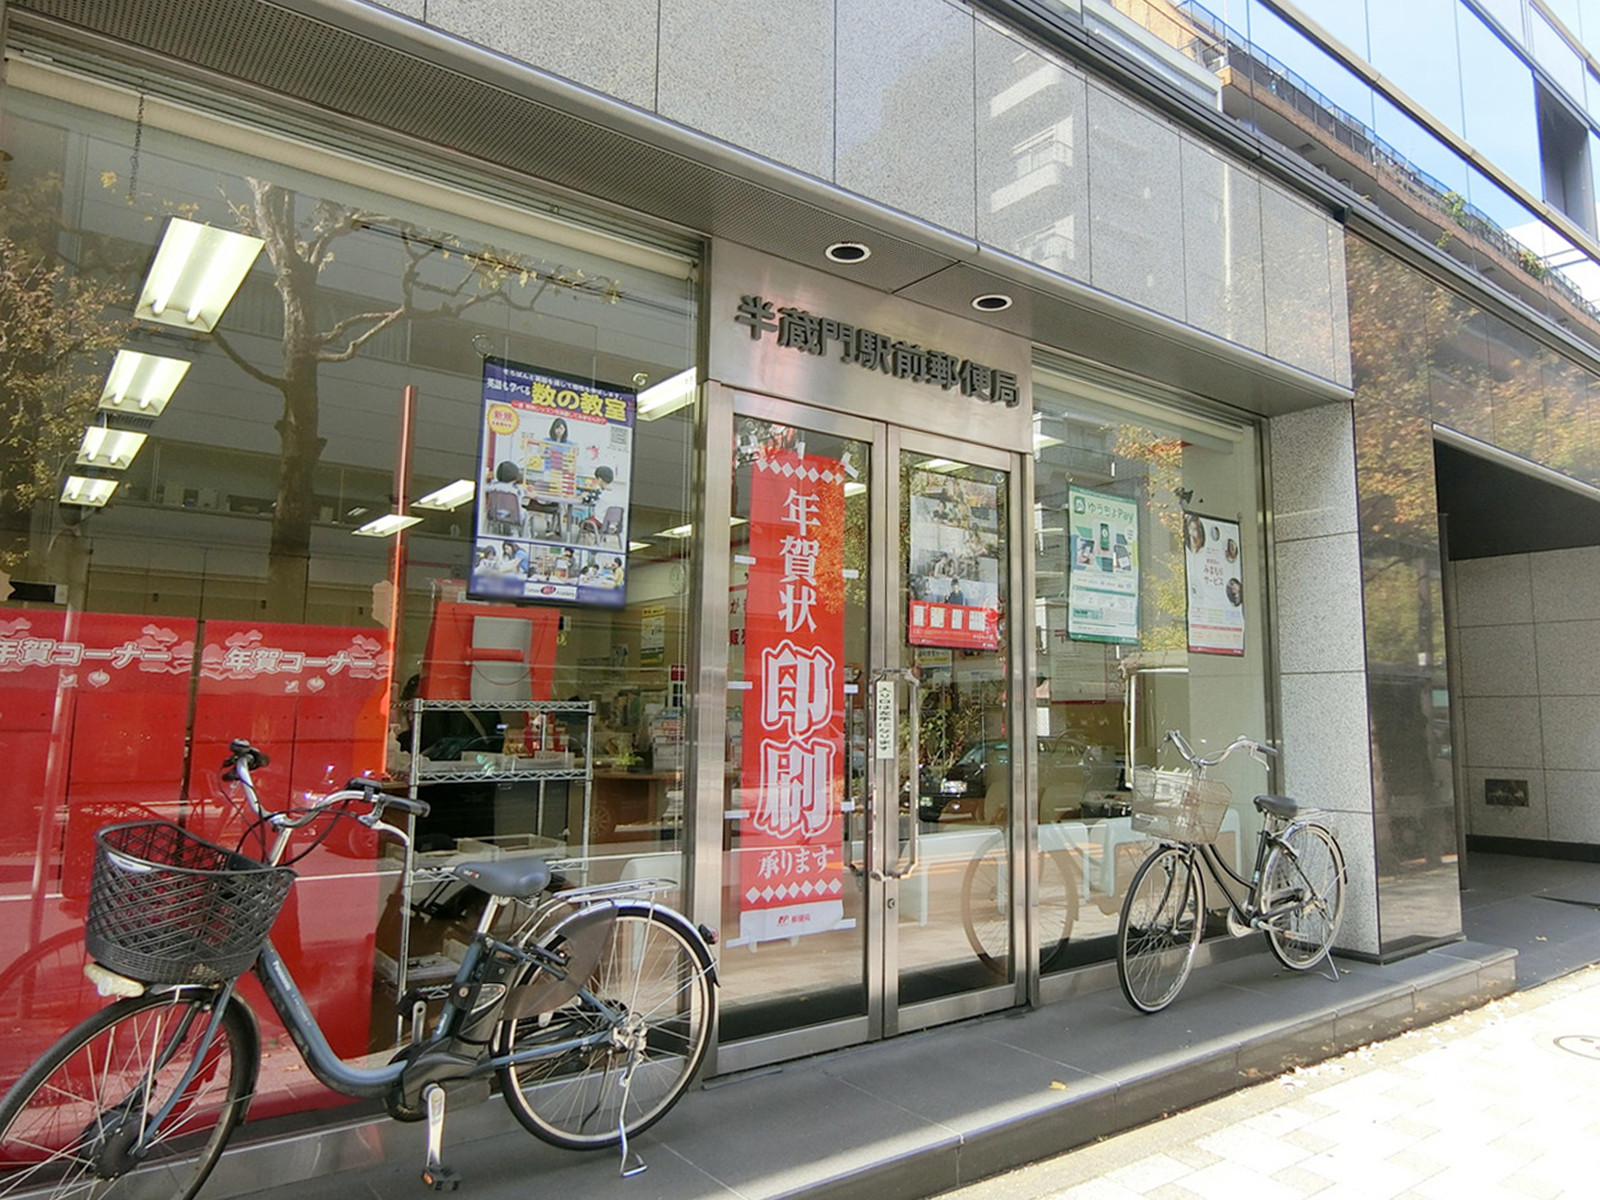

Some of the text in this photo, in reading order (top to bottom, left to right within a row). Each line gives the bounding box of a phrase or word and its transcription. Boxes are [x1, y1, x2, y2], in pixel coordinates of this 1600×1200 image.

[735, 295, 1020, 407] 半蔵門駅前郵便局
[531, 381, 627, 422] 数の教室
[778, 487, 821, 634] 年賀状
[224, 647, 376, 676] 年賀コーナー
[753, 639, 836, 840] 印刷
[757, 844, 834, 880] 承ります
